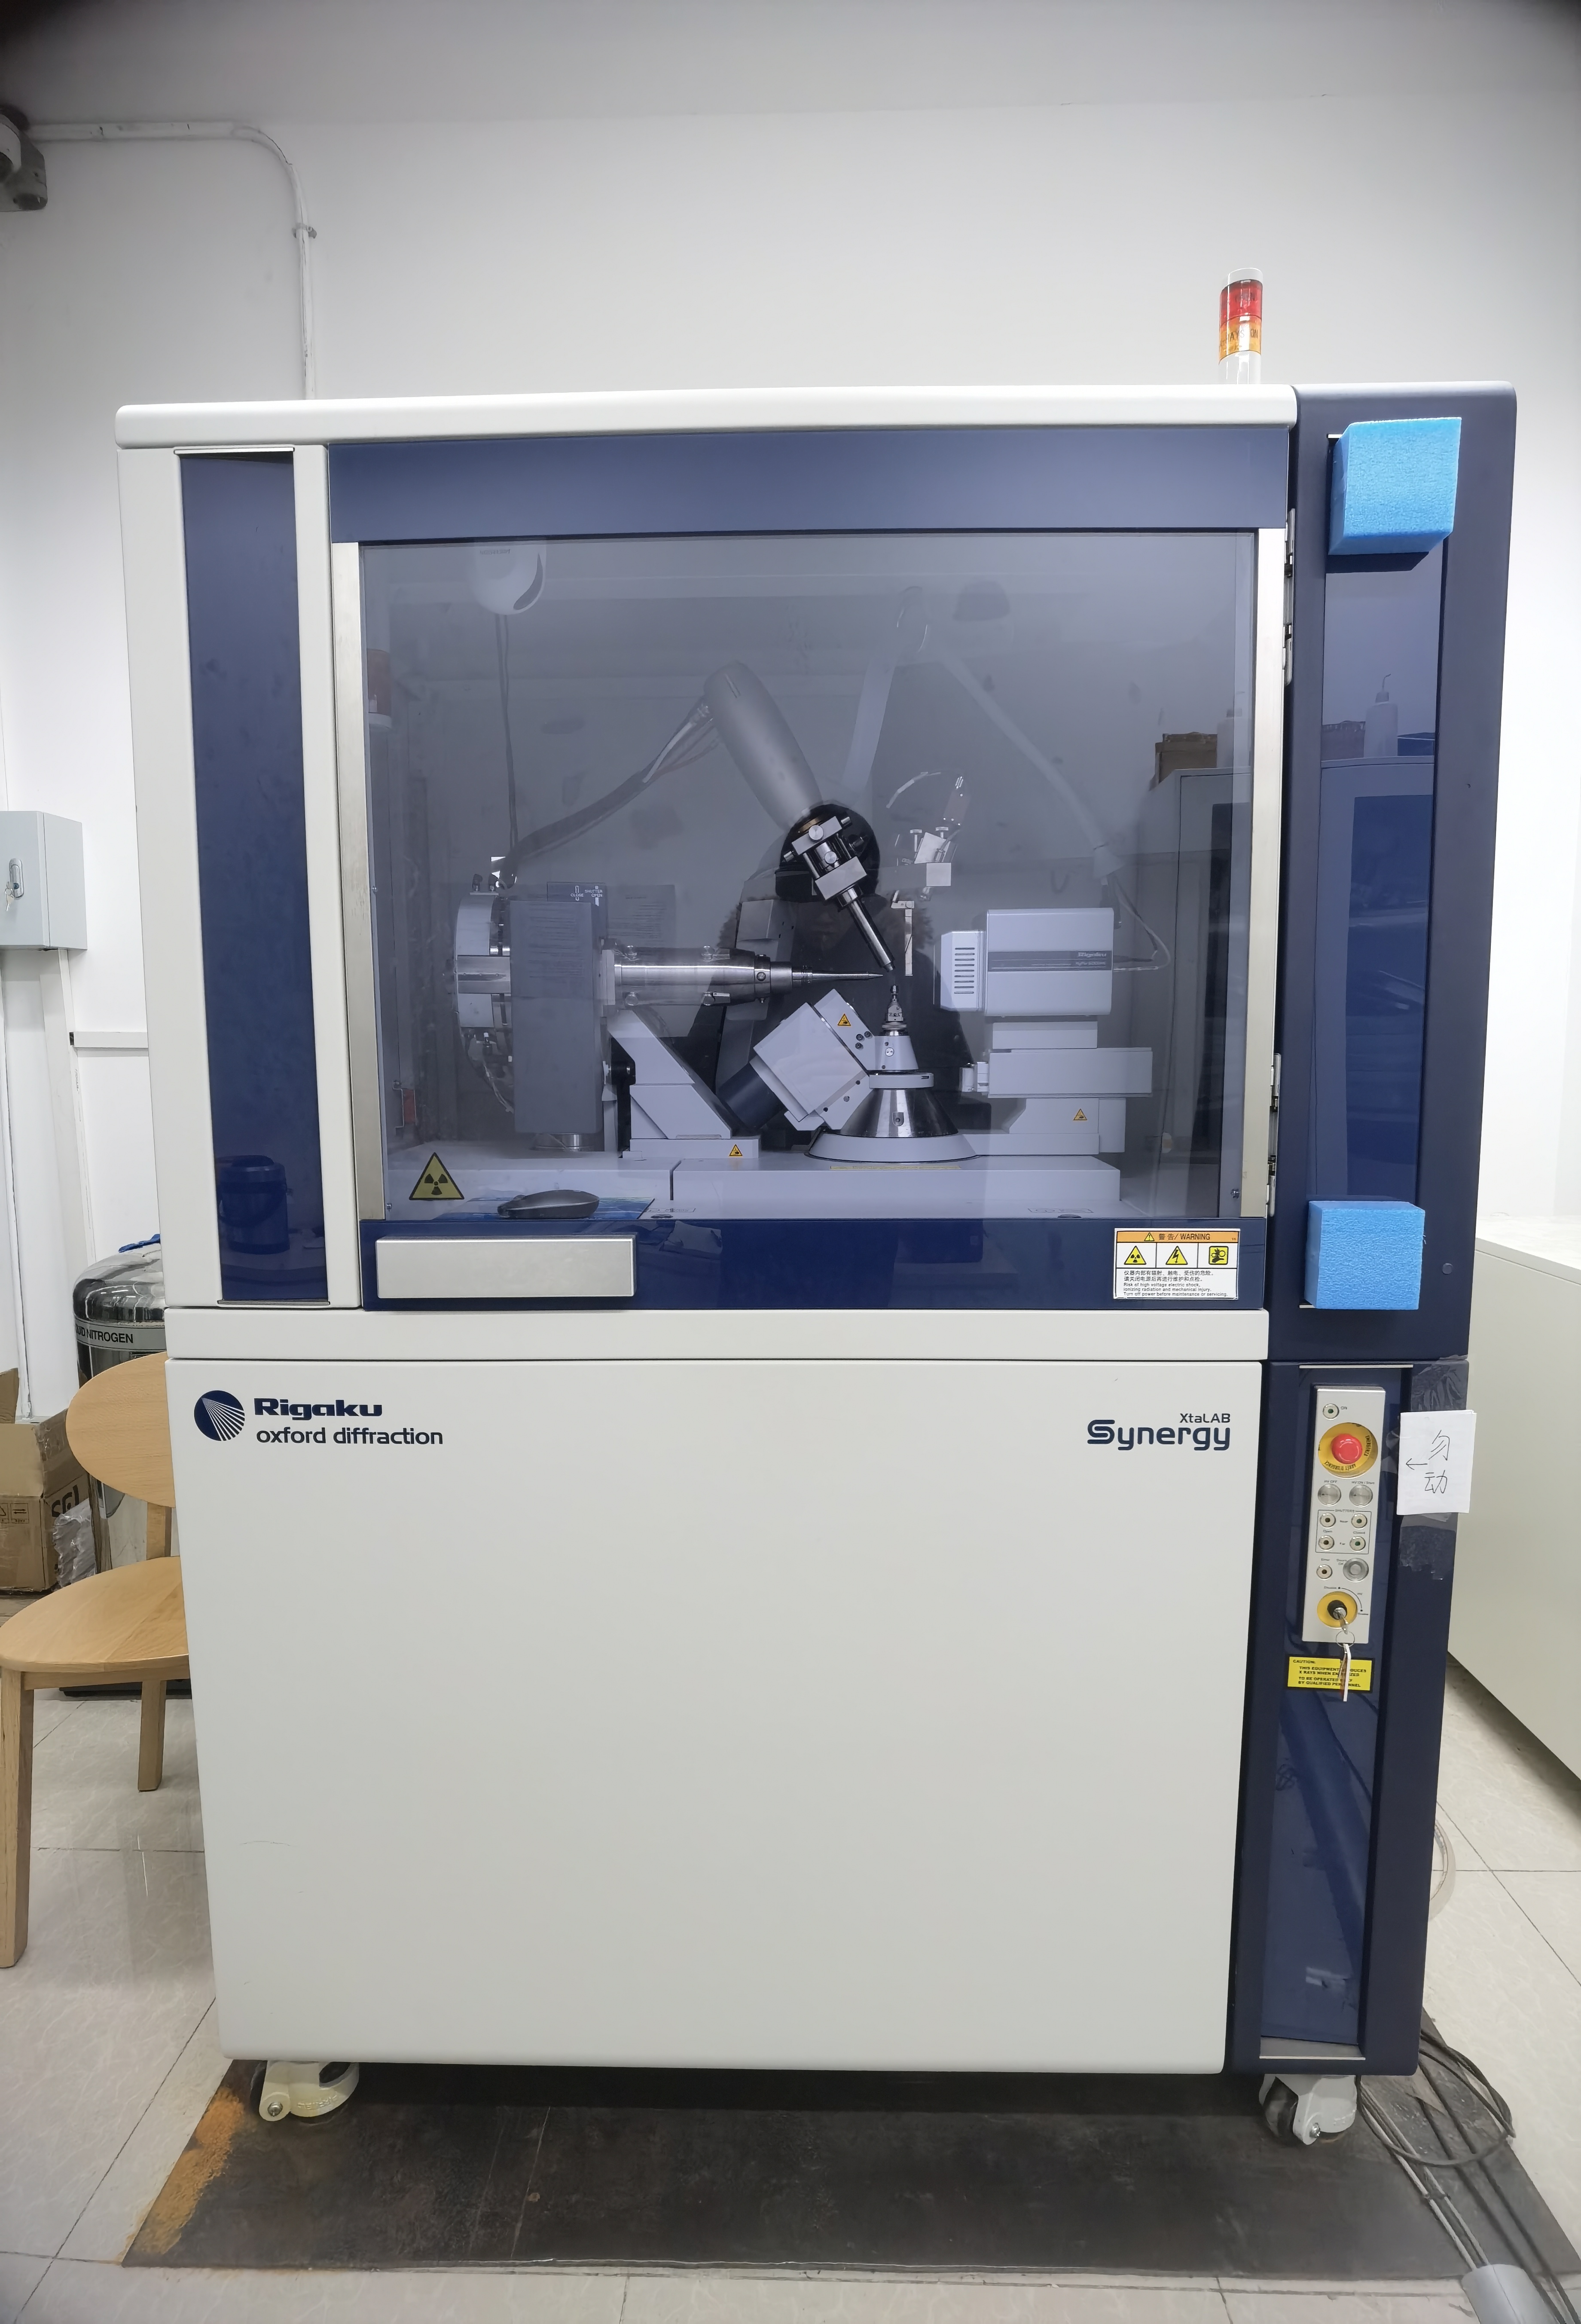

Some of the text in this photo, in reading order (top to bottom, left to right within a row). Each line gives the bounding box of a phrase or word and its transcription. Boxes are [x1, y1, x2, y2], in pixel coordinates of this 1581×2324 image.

[86, 1329, 134, 1343] NITROGEN
[254, 1398, 382, 1421] Rigaku
[1179, 1413, 1230, 1423] XtaLAB
[256, 1427, 443, 1445] oxford diffraction
[1087, 1419, 1230, 1451] Synergy
[1424, 1429, 1450, 1494] 勿动
